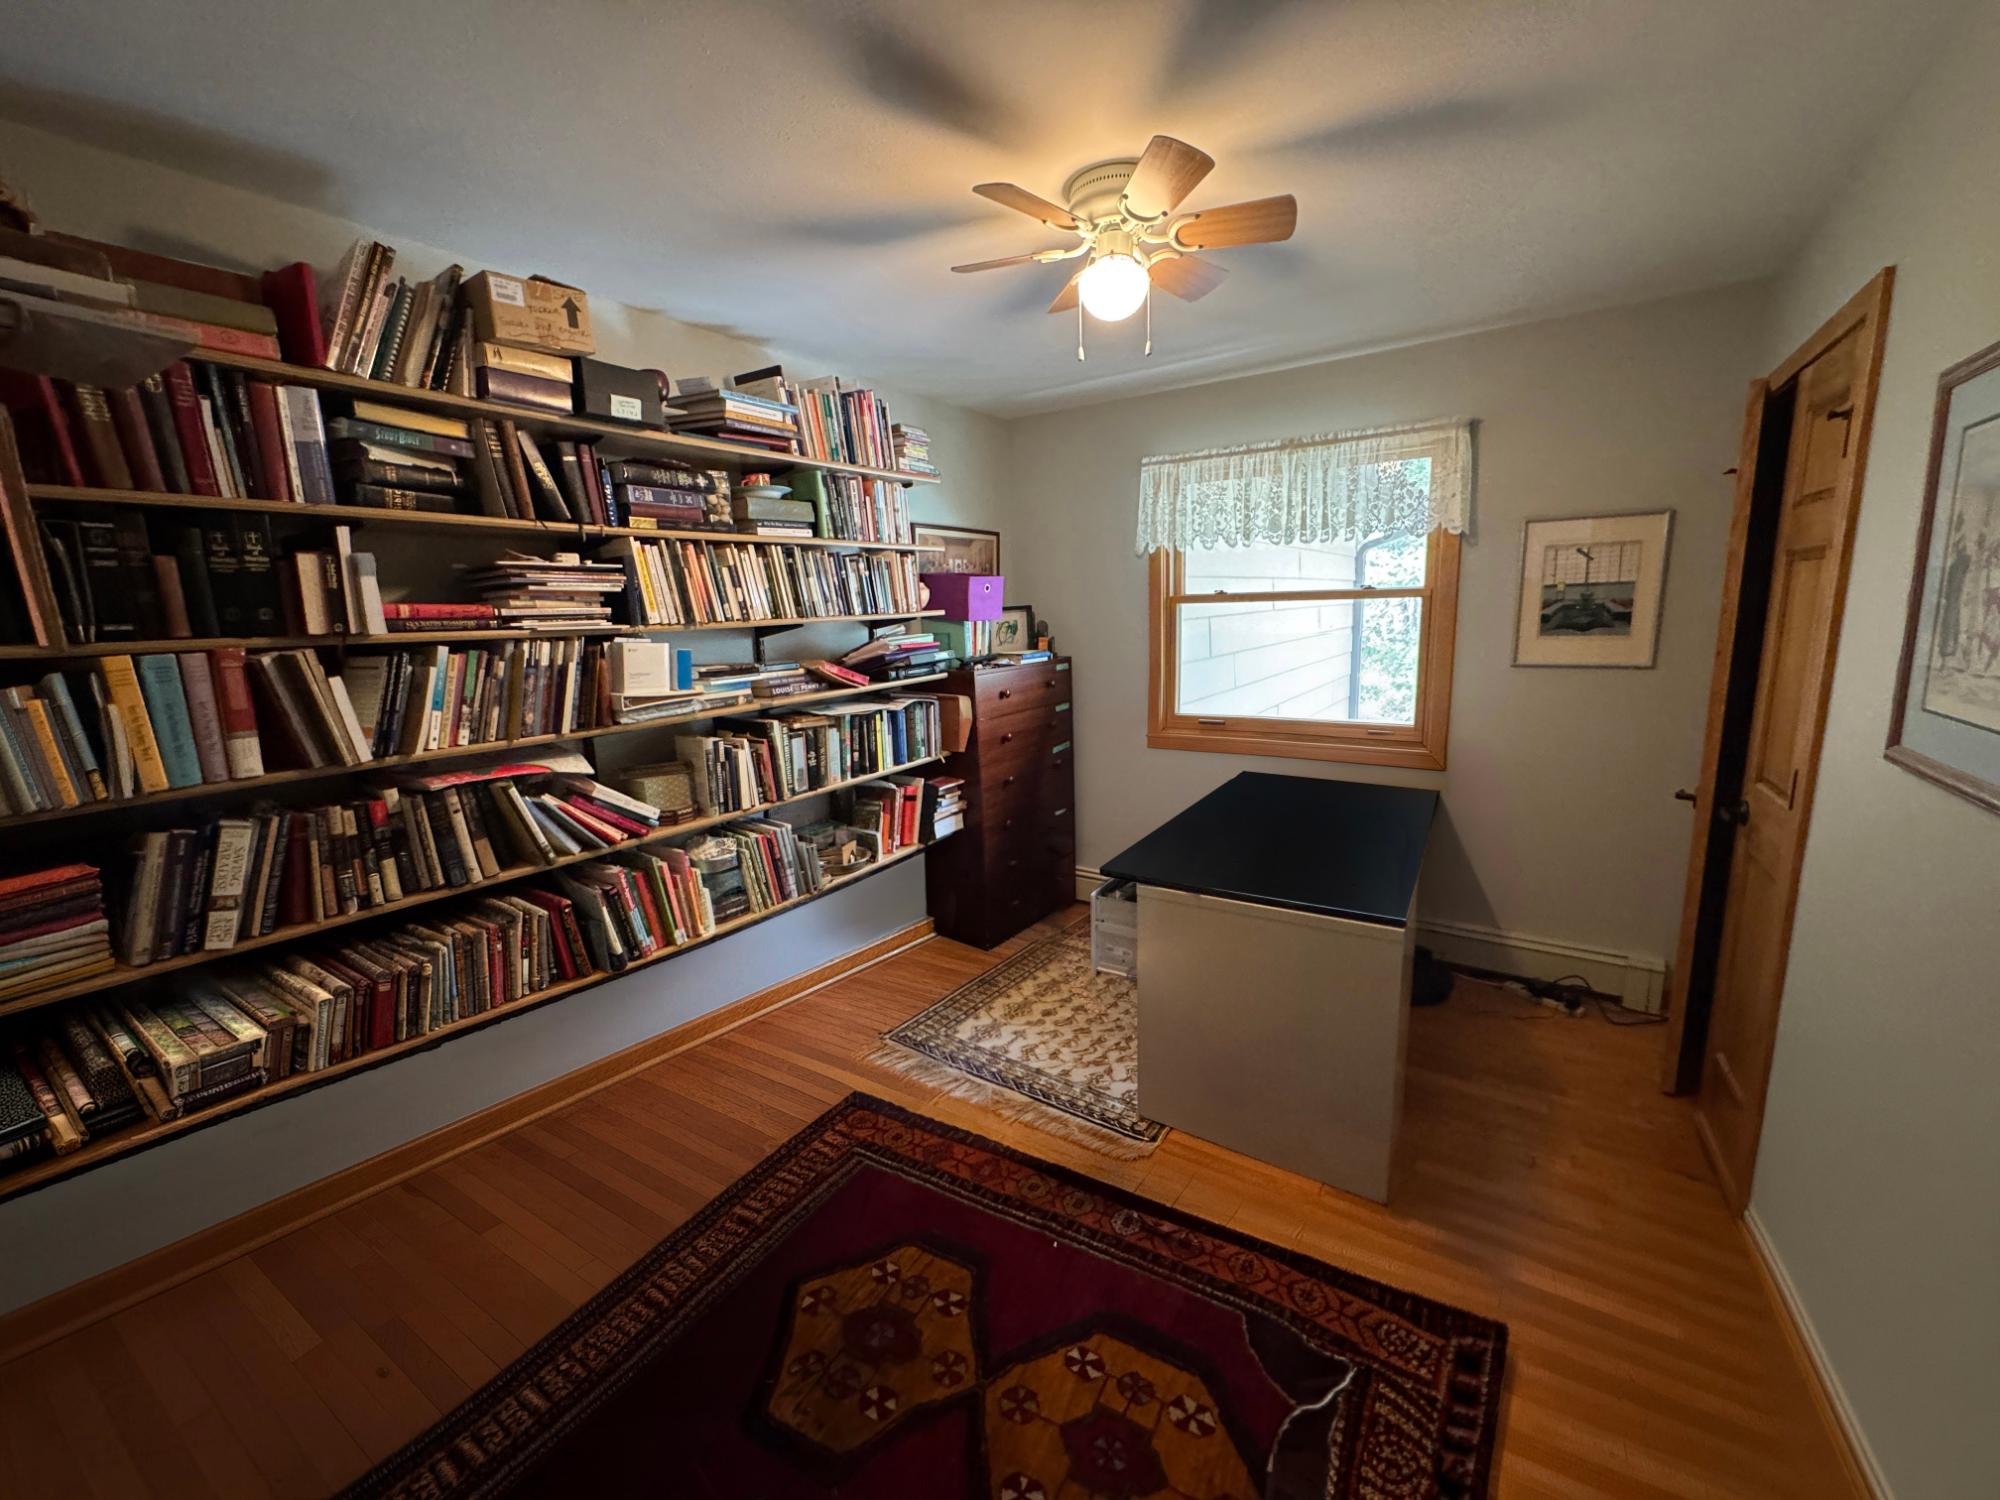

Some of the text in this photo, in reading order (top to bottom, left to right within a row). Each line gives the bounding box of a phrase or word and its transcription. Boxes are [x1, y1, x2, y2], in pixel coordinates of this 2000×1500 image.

[375, 427, 399, 442] STUDY
[772, 685, 794, 696] LOUISE
[214, 840, 233, 893] PARADISE
[229, 844, 246, 888] SAVING
